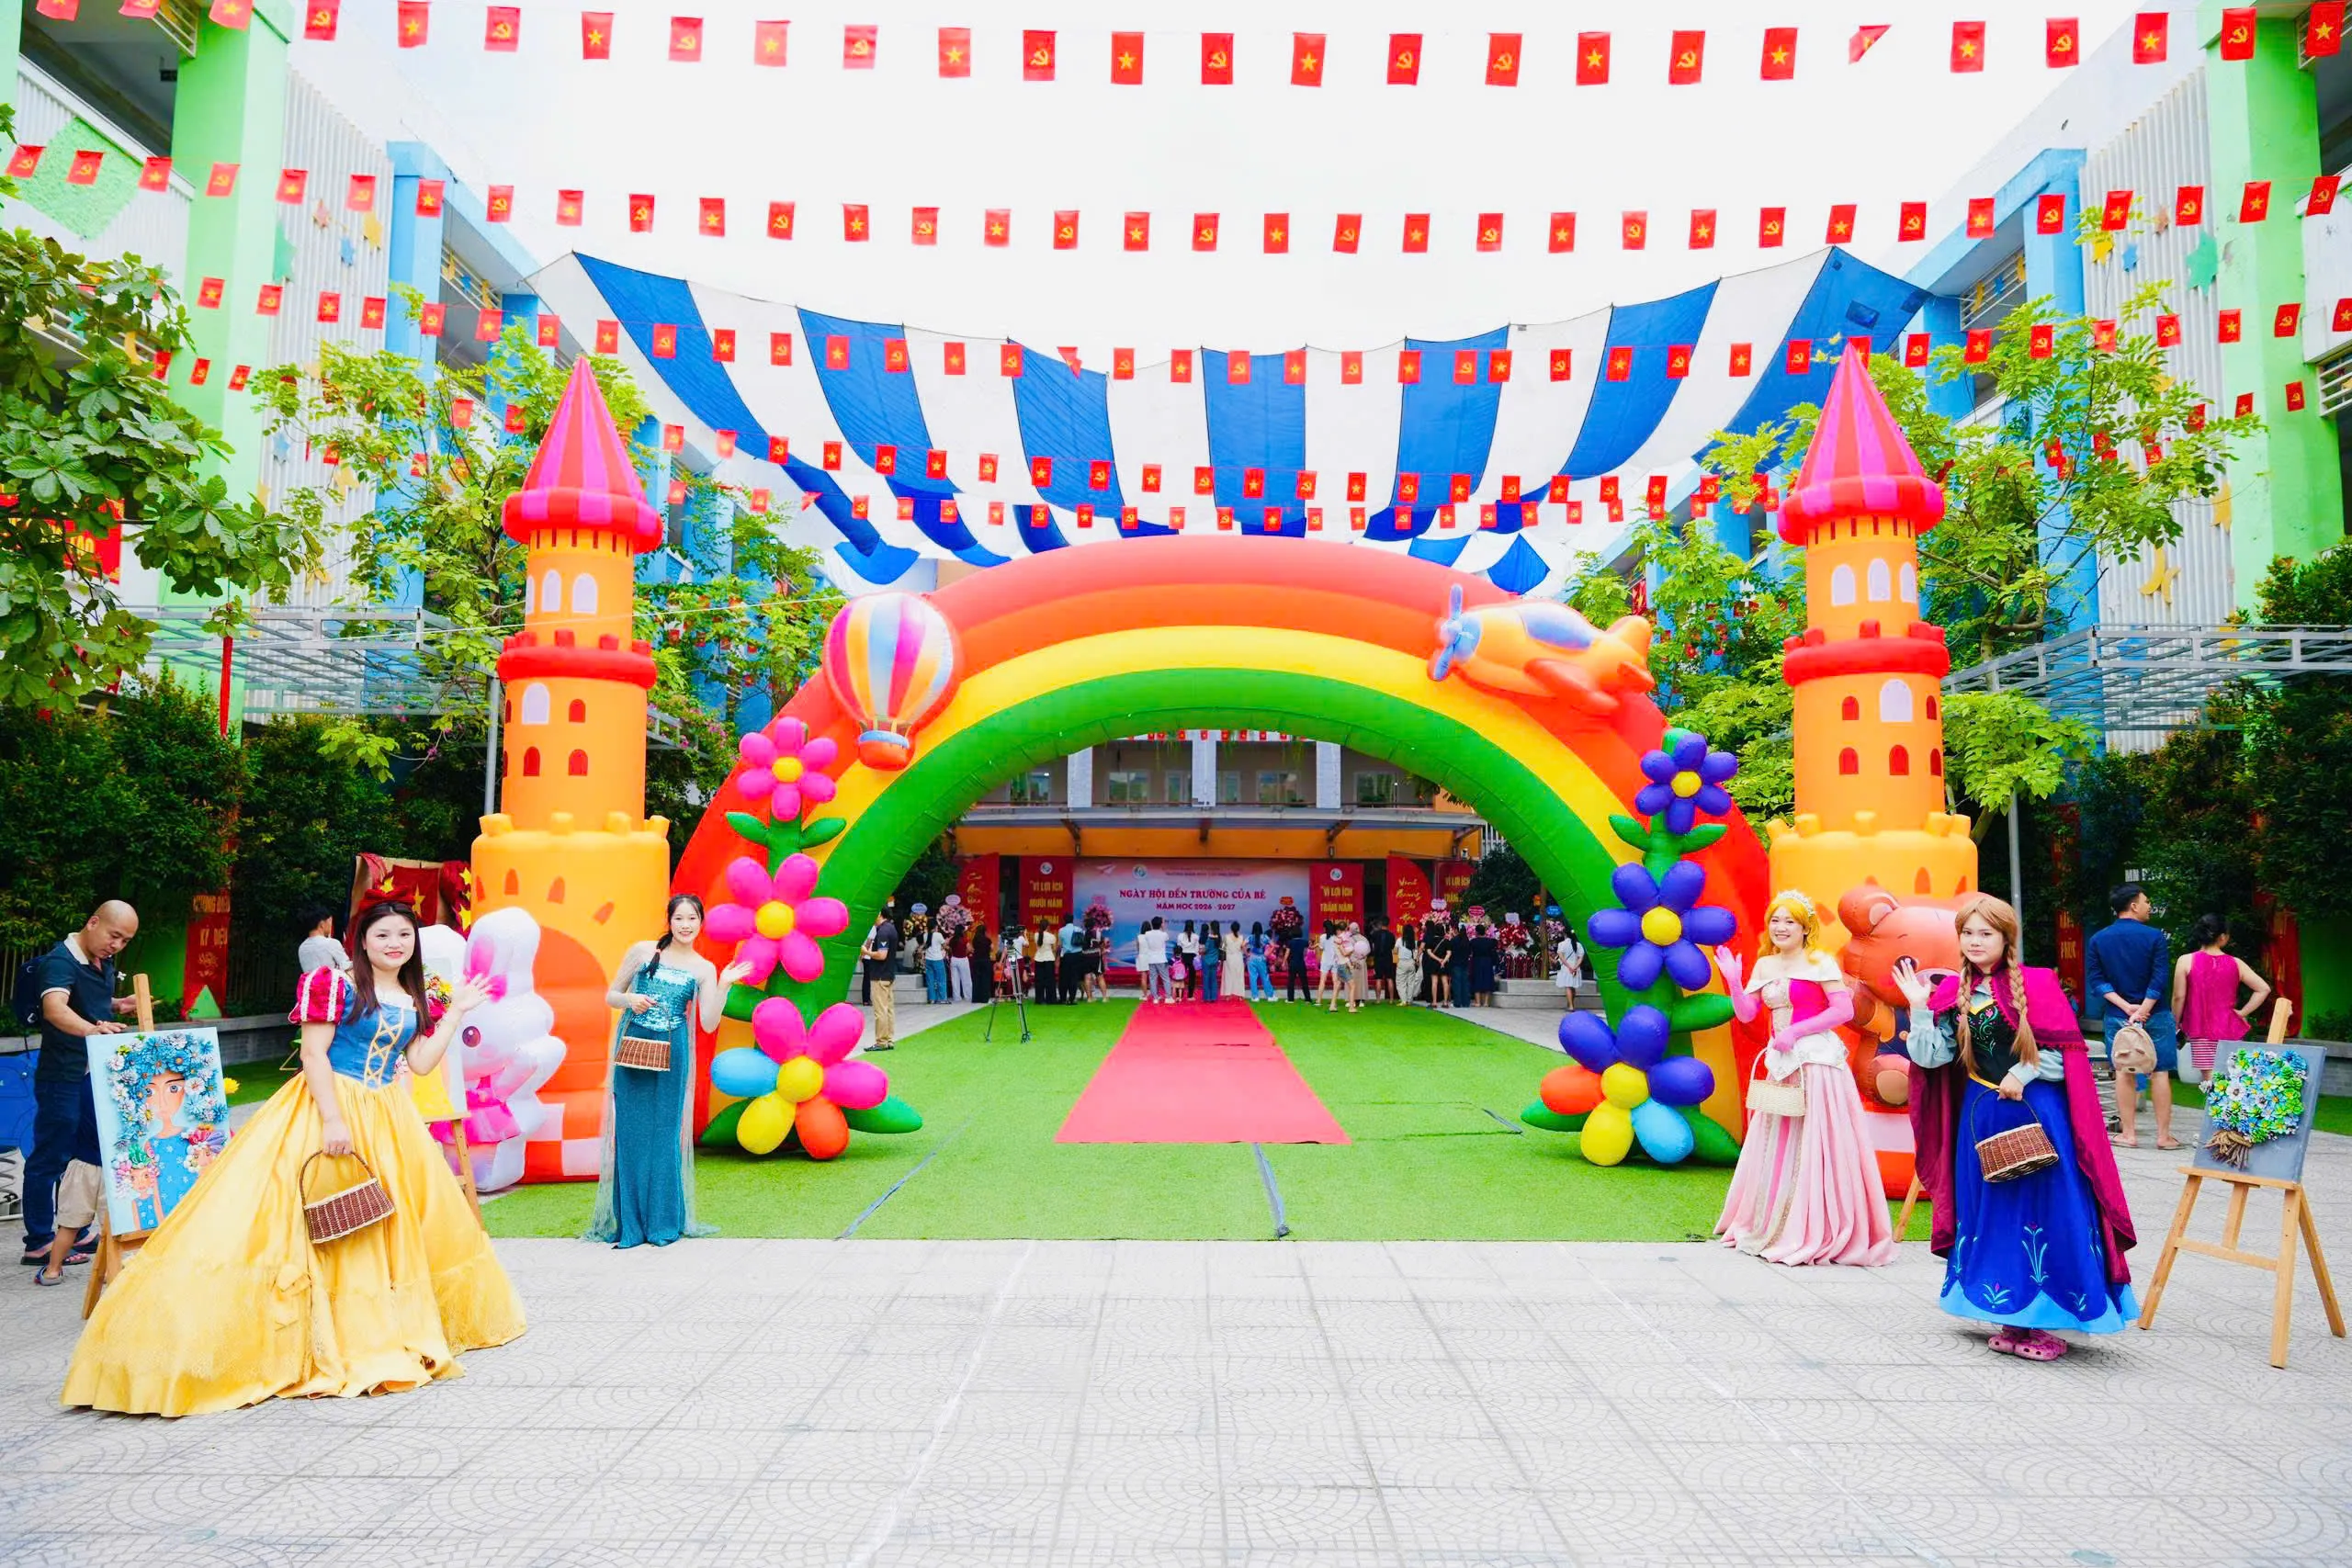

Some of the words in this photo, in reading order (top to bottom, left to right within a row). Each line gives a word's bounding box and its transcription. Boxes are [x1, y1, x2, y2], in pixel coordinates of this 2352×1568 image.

[1119, 887, 1147, 898] NGÀY
[1148, 888, 1166, 901] HỘI
[1190, 888, 1229, 899] TRƯỜNG
[1231, 888, 1251, 899] CỦA
[1156, 901, 1175, 910] NĂM
